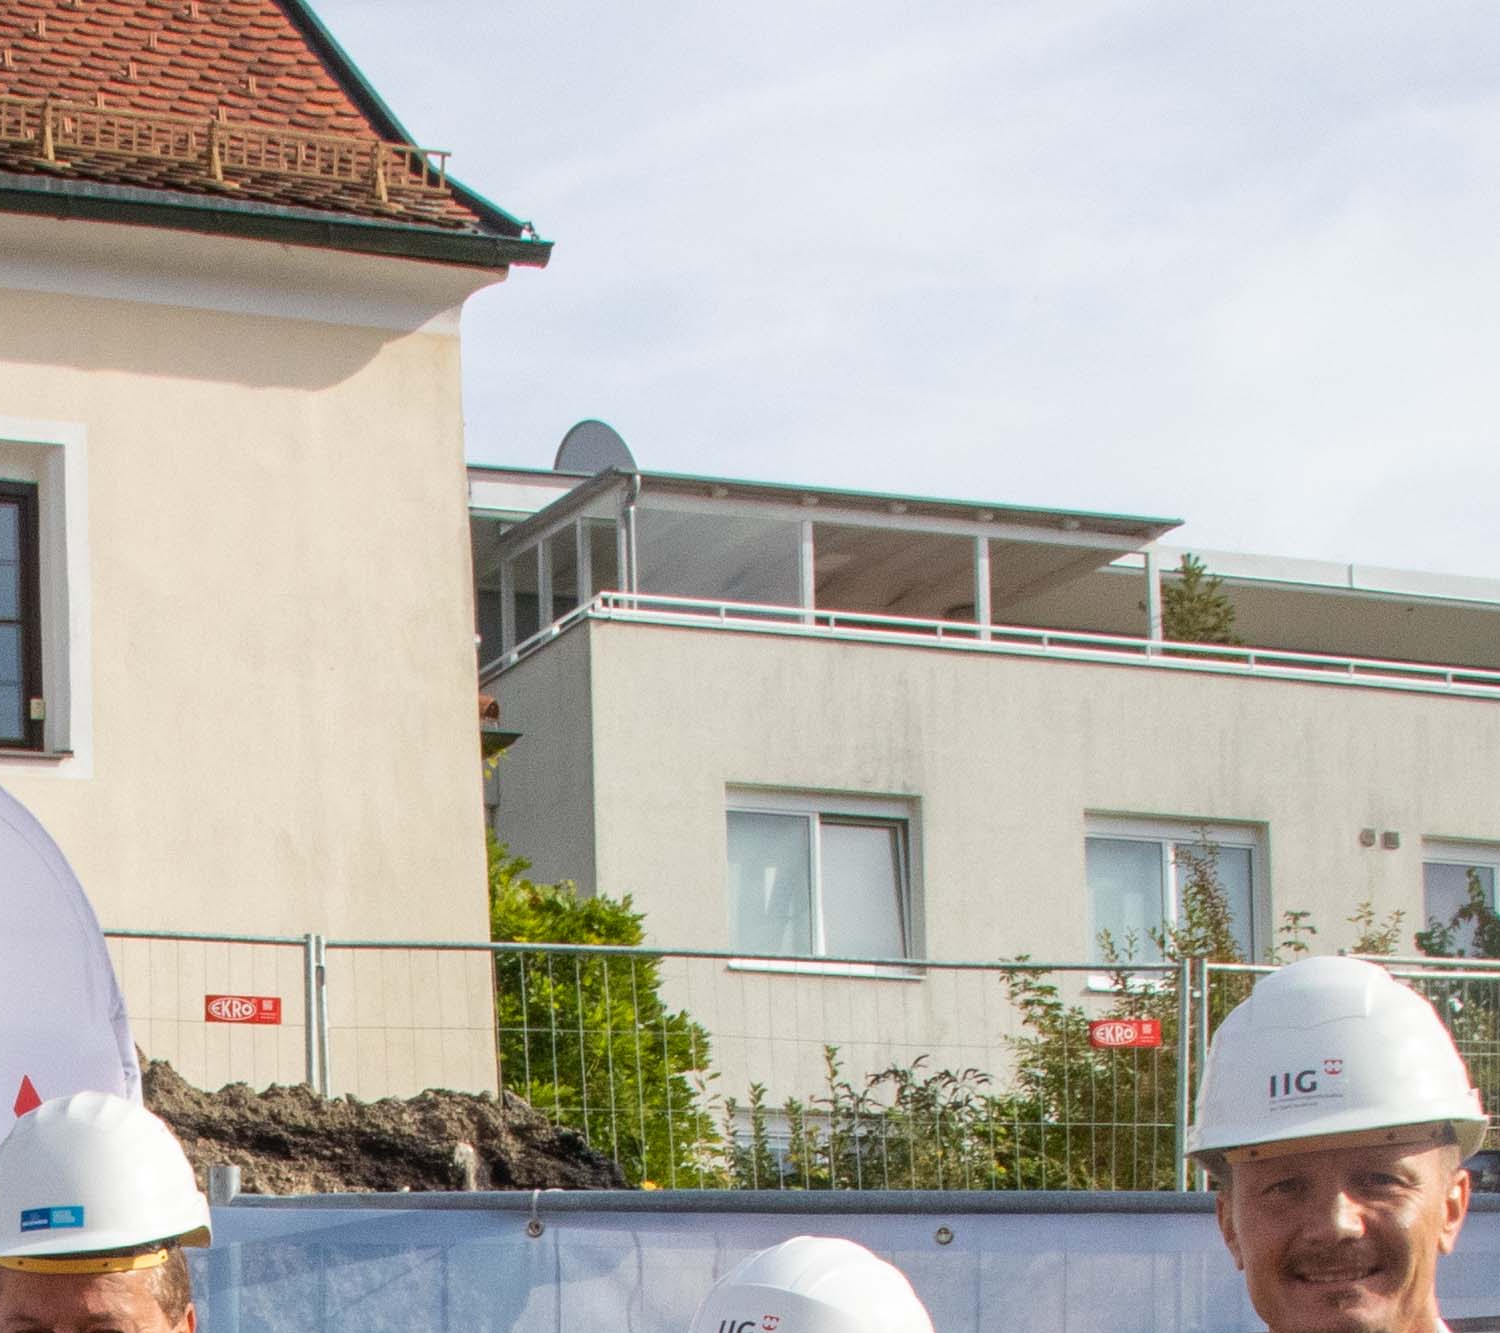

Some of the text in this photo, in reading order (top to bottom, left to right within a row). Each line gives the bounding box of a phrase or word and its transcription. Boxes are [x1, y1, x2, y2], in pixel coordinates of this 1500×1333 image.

[211, 999, 253, 1018] EKRO
[1095, 1024, 1134, 1043] EKRO
[1269, 1070, 1317, 1098] IIG
